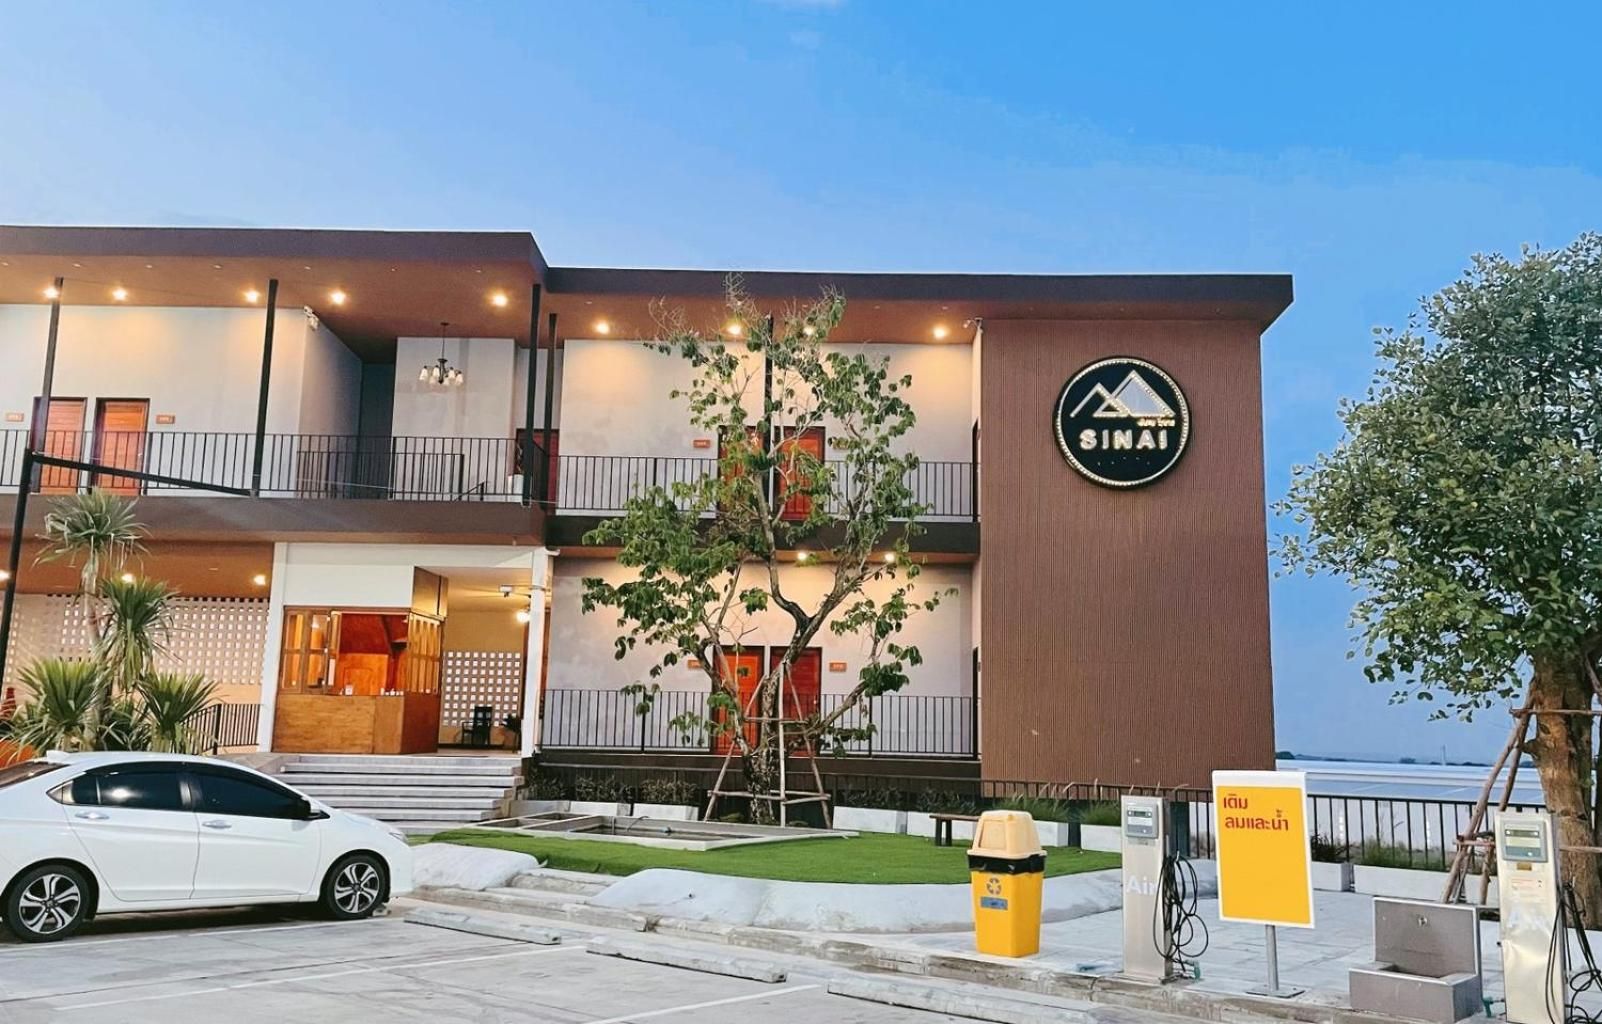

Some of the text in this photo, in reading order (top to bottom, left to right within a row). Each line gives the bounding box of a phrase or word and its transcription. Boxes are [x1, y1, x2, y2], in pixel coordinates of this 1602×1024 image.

[1080, 428, 1168, 450] SINAI
[1225, 809, 1289, 831] ลมและน้ำ
[1126, 875, 1157, 896] Air
